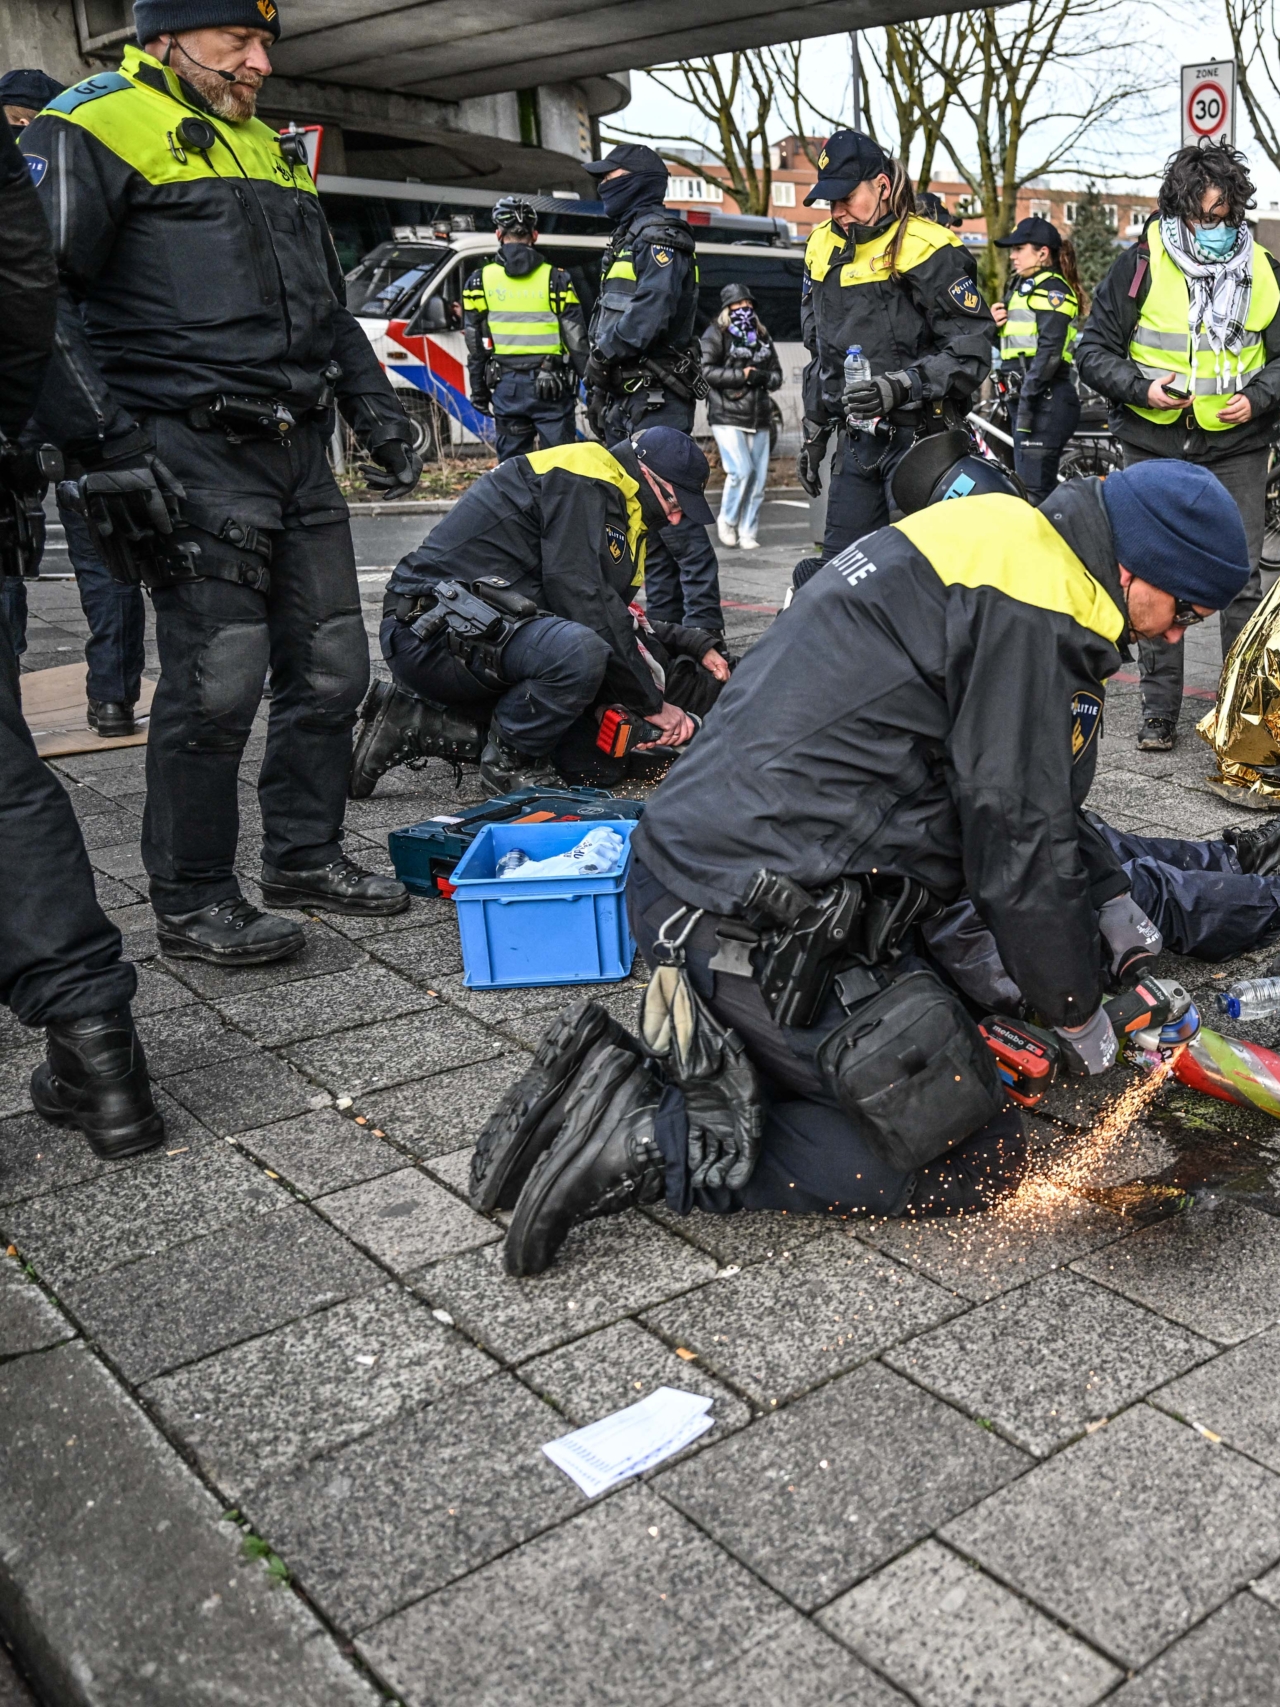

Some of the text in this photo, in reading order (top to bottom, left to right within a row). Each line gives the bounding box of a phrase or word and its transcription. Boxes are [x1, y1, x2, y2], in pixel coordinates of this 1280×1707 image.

[1195, 68, 1219, 79] ZONE
[74, 80, 108, 94] GC
[1195, 98, 1220, 120] 30
[992, 1025, 1025, 1046] metabo
